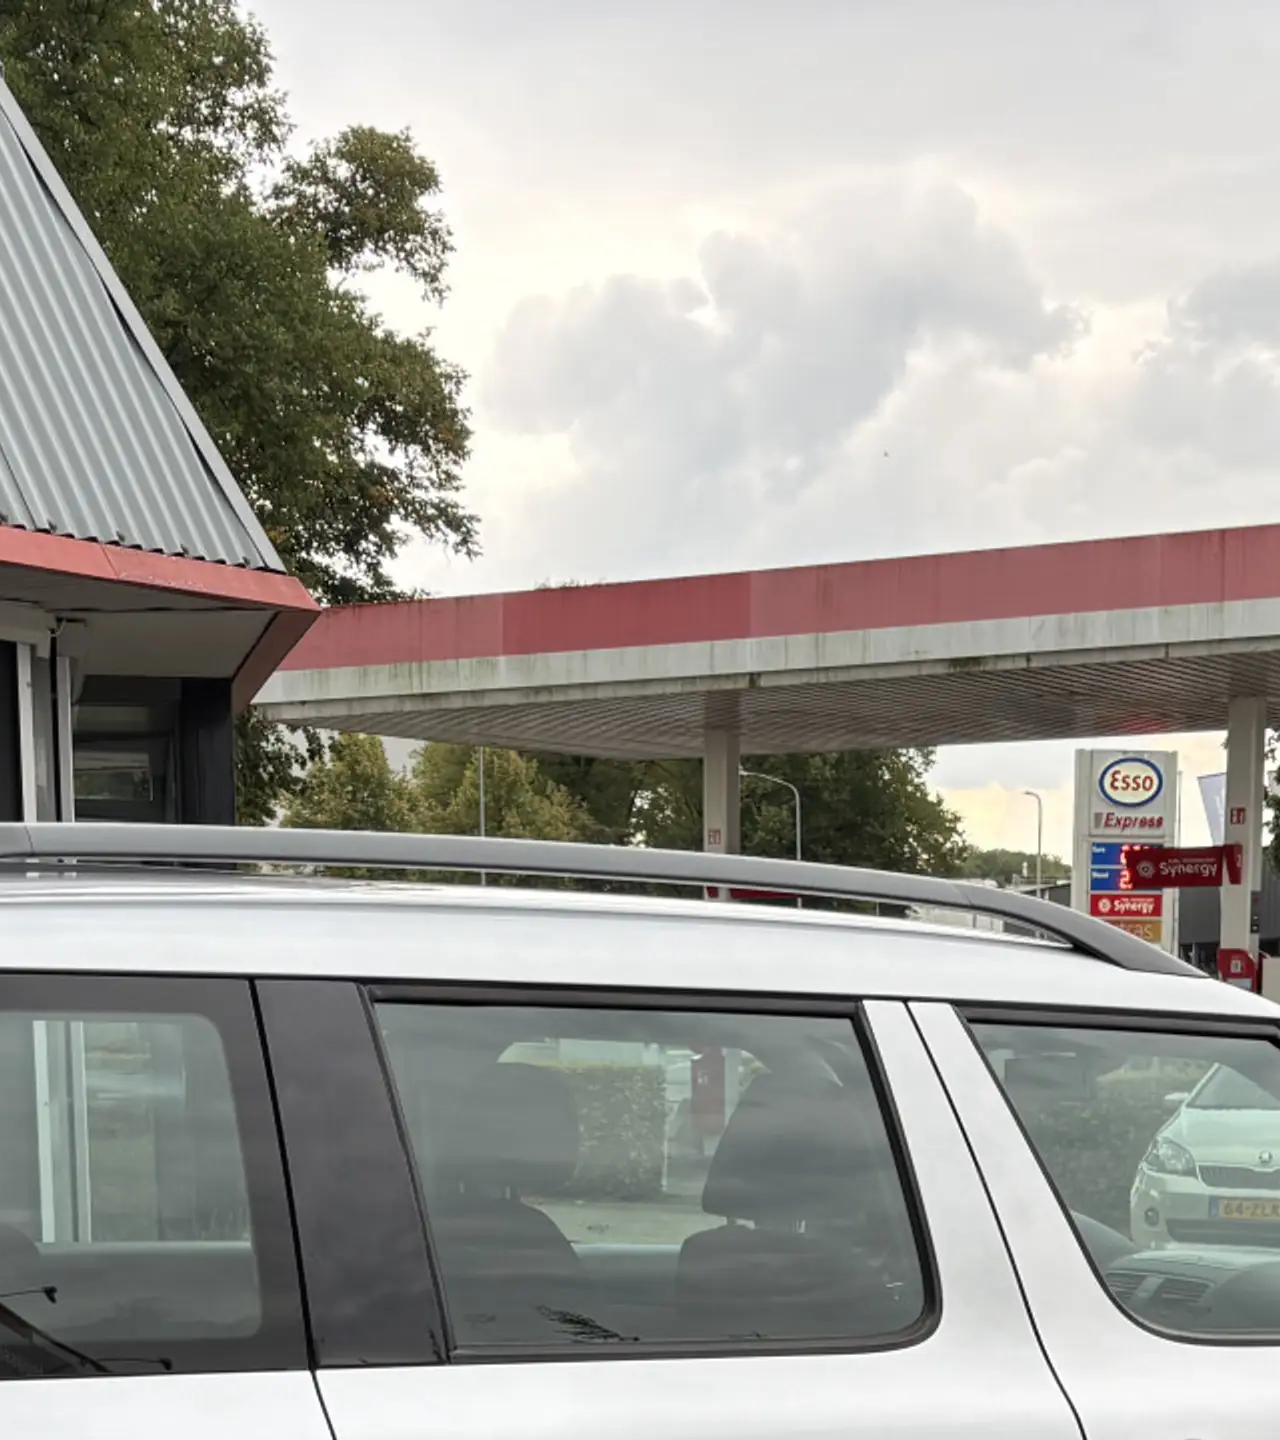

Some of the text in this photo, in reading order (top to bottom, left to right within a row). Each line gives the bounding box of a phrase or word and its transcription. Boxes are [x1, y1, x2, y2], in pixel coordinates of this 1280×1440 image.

[1109, 769, 1154, 792] Esso
[1103, 811, 1164, 833] Express
[1159, 861, 1218, 878] Synergy
[1113, 899, 1155, 914] Synergy
